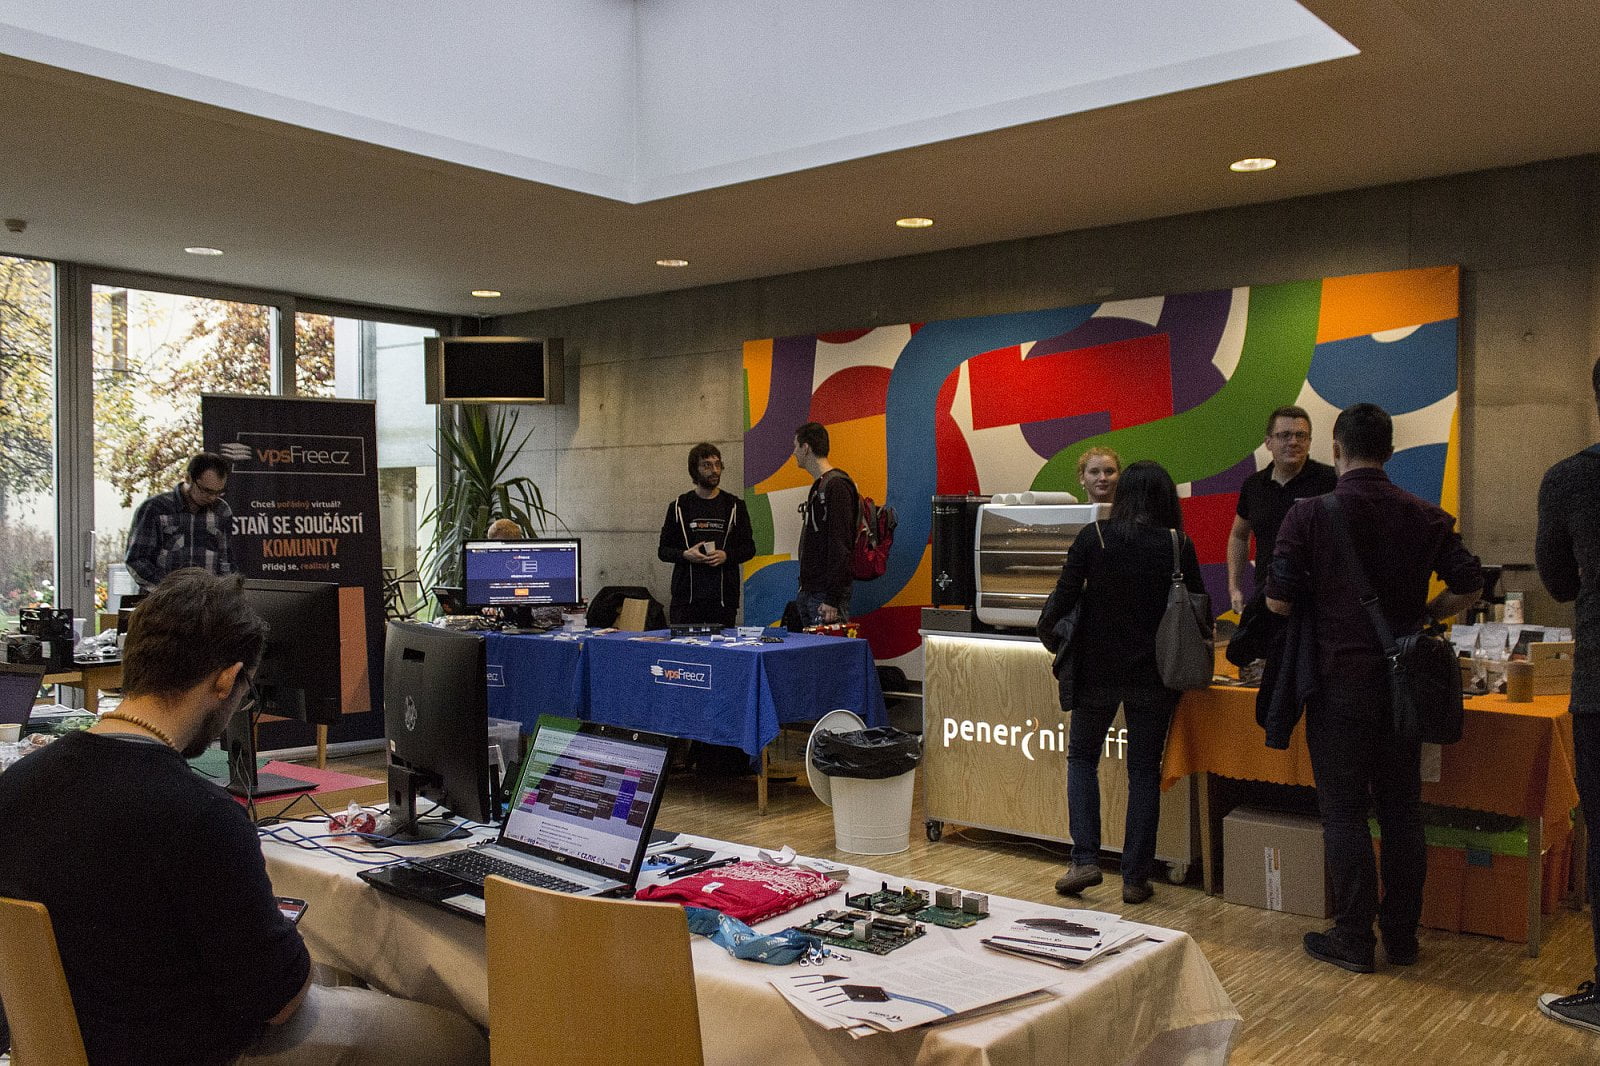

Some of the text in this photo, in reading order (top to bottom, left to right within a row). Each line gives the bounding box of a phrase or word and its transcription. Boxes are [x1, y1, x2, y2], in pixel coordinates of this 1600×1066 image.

[257, 445, 349, 466] vpsFree.cz
[232, 512, 363, 535] STAŇ SE SOUČÁSTÍ
[262, 538, 339, 558] KOMUNITY
[663, 668, 705, 683] vpsFree.cz
